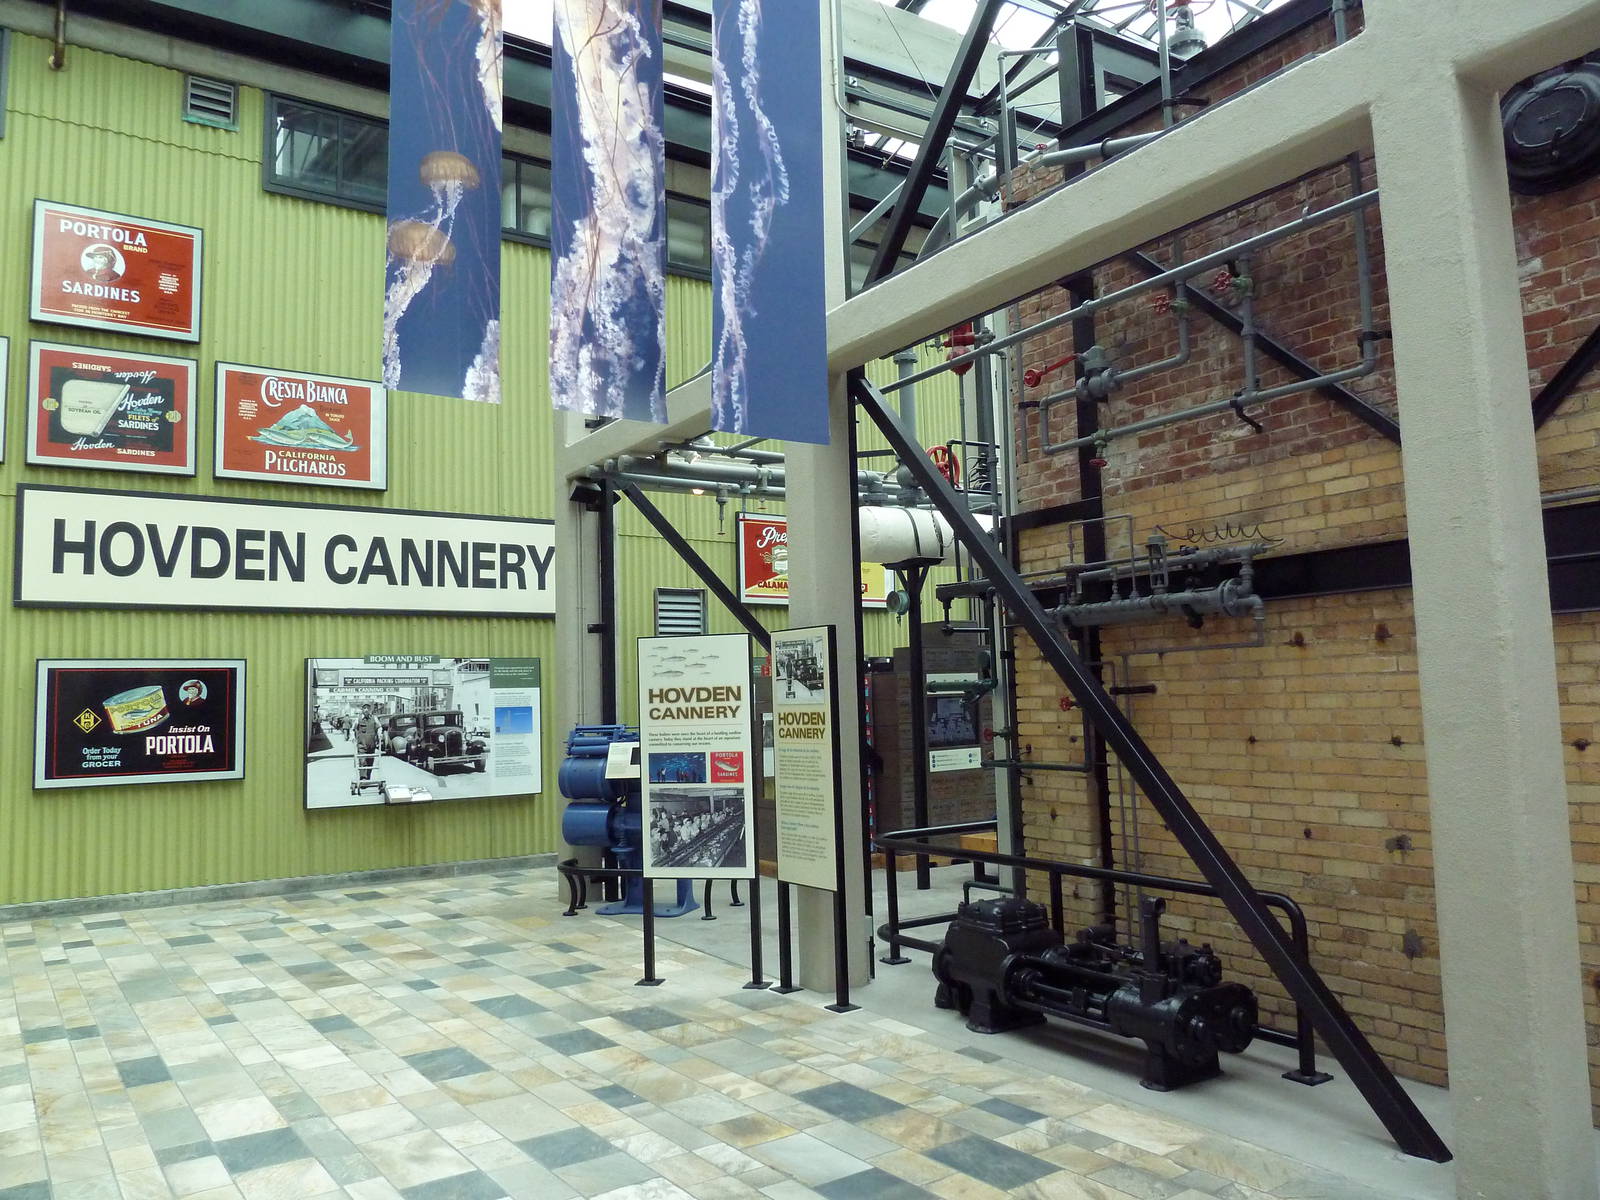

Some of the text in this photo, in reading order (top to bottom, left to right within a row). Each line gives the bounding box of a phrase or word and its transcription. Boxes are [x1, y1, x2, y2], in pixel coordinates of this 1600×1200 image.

[60, 219, 148, 247] PORTOLA
[123, 244, 148, 254] BRAND
[62, 280, 141, 303] SARDINES
[72, 362, 112, 372] SARDINES
[261, 376, 304, 407] CRESTA
[306, 381, 348, 404] BLANCA
[118, 393, 165, 411] Hovden
[118, 419, 159, 431] SARDINES
[128, 414, 151, 422] FILETS
[71, 437, 115, 451] Hovden
[117, 448, 156, 457] SARDINES
[278, 450, 336, 462] CALIFORNIA
[265, 450, 346, 476] PILCHARDS
[757, 526, 788, 548] Pre
[52, 518, 555, 591] HOVDEN CANNERY
[370, 655, 395, 663] BOOM
[648, 686, 742, 704] HOVDEN
[649, 706, 740, 720] CANNERY
[778, 712, 826, 726] HOVDEN
[137, 714, 163, 728] TUNA
[168, 725, 211, 734] Insist On
[778, 728, 826, 739] CANNERY
[82, 747, 122, 755] Order Today
[145, 735, 215, 755] PORTOLA
[82, 760, 121, 768] GROCER
